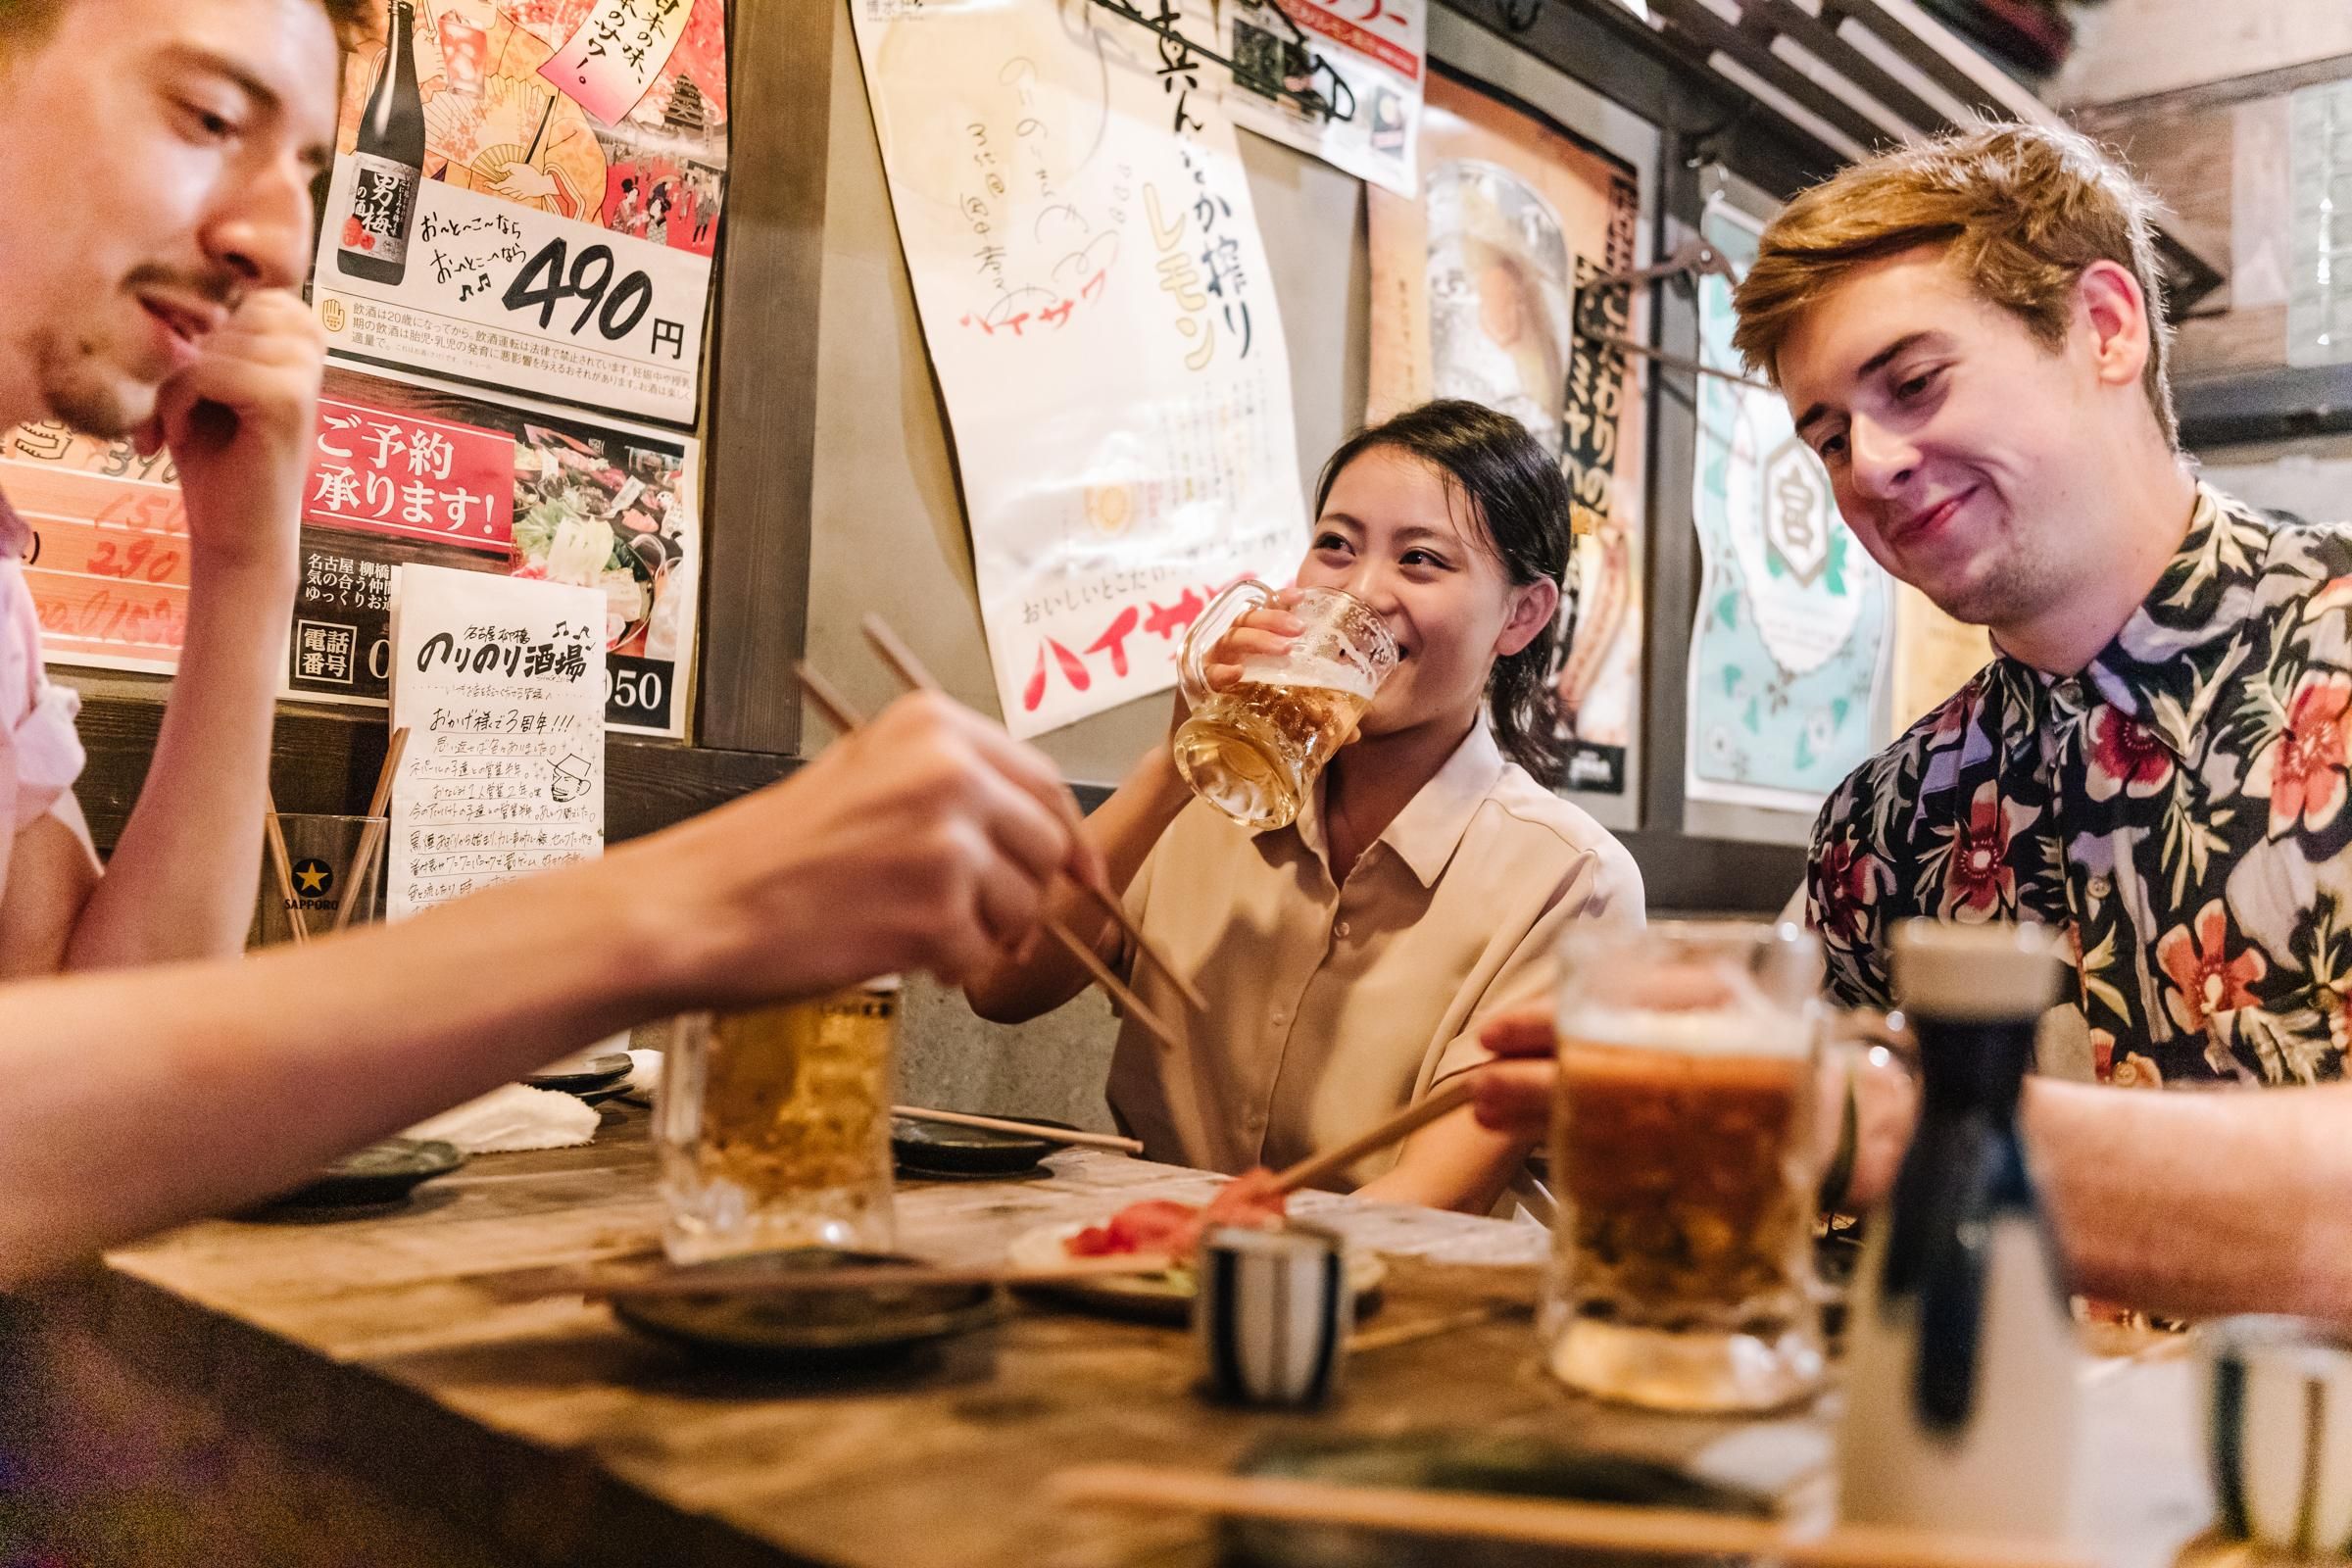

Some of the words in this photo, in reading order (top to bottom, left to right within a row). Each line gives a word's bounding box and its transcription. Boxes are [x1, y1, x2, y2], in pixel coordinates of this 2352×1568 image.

[1143, 182, 1214, 371] レモン
[318, 414, 455, 480] ご予約
[87, 538, 180, 583] 290
[308, 553, 354, 574] 名古屋
[359, 561, 392, 579] 柳橋
[304, 628, 350, 656] 電話
[416, 632, 587, 684] のりのり酒場
[302, 652, 348, 678] 番号
[282, 899, 338, 910] SAPPORO
